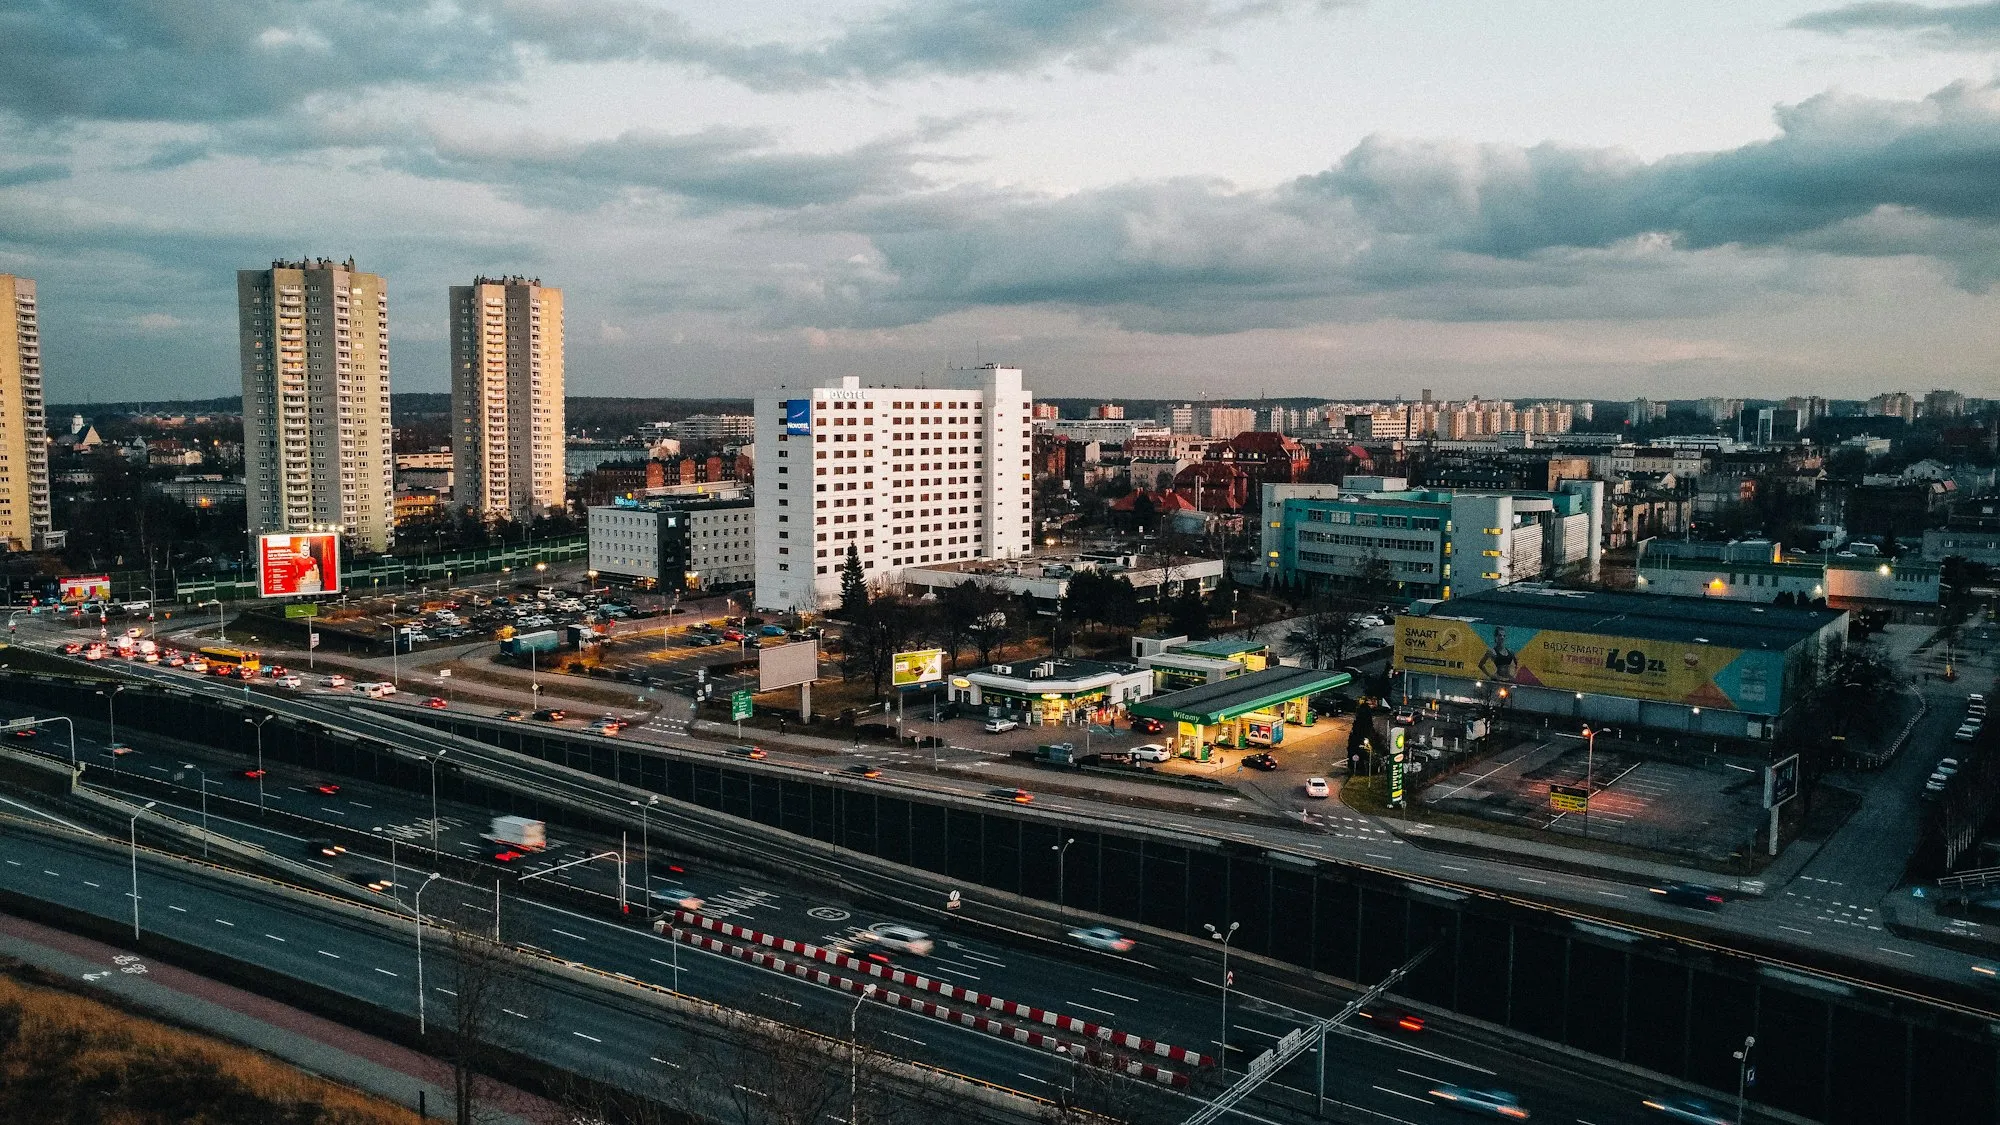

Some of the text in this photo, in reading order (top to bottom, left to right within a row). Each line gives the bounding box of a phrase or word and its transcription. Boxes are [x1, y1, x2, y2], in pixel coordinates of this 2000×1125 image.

[1405, 627, 1438, 639] SMART
[1405, 638, 1426, 648] GYM
[1570, 644, 1604, 655] SMART
[1605, 648, 1646, 674] 49
[1172, 710, 1200, 723] Witamy
